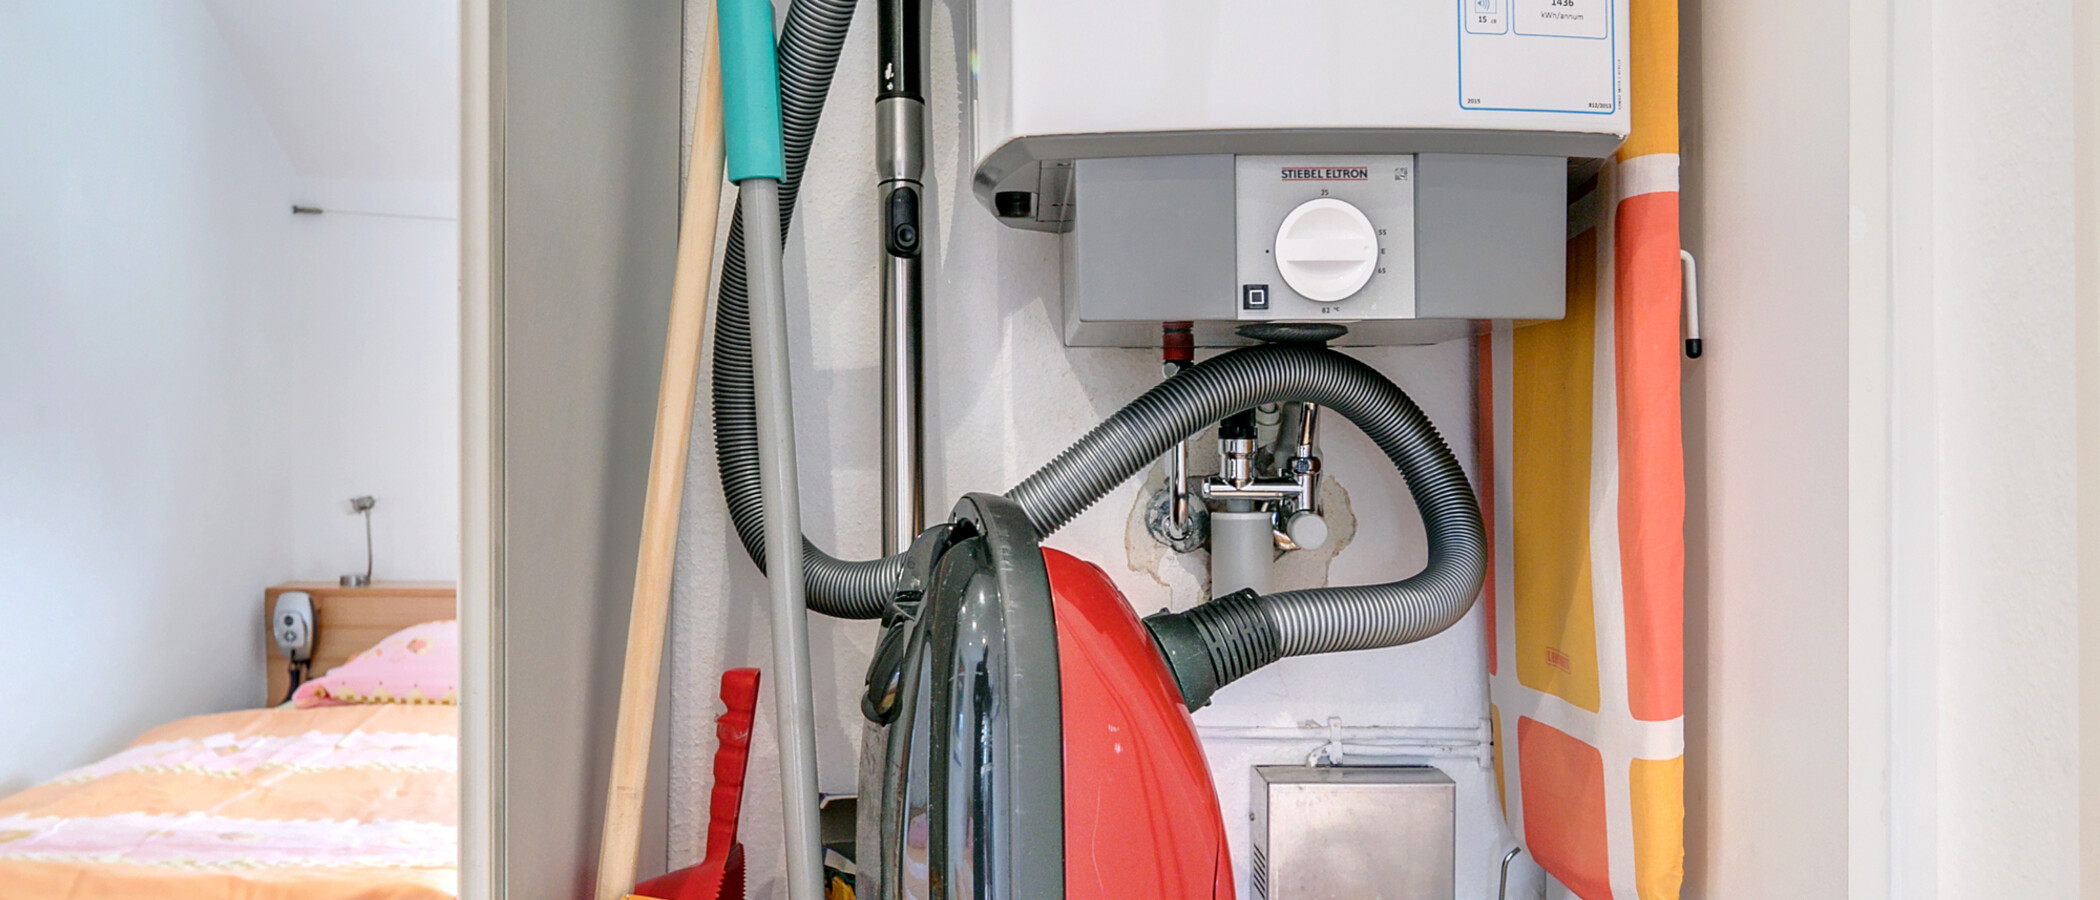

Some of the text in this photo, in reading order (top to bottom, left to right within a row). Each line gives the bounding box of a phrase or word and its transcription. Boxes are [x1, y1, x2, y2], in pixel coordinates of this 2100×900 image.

[1478, 15, 1487, 23] 15
[1281, 169, 1368, 179] STIEBEL ELTRON
